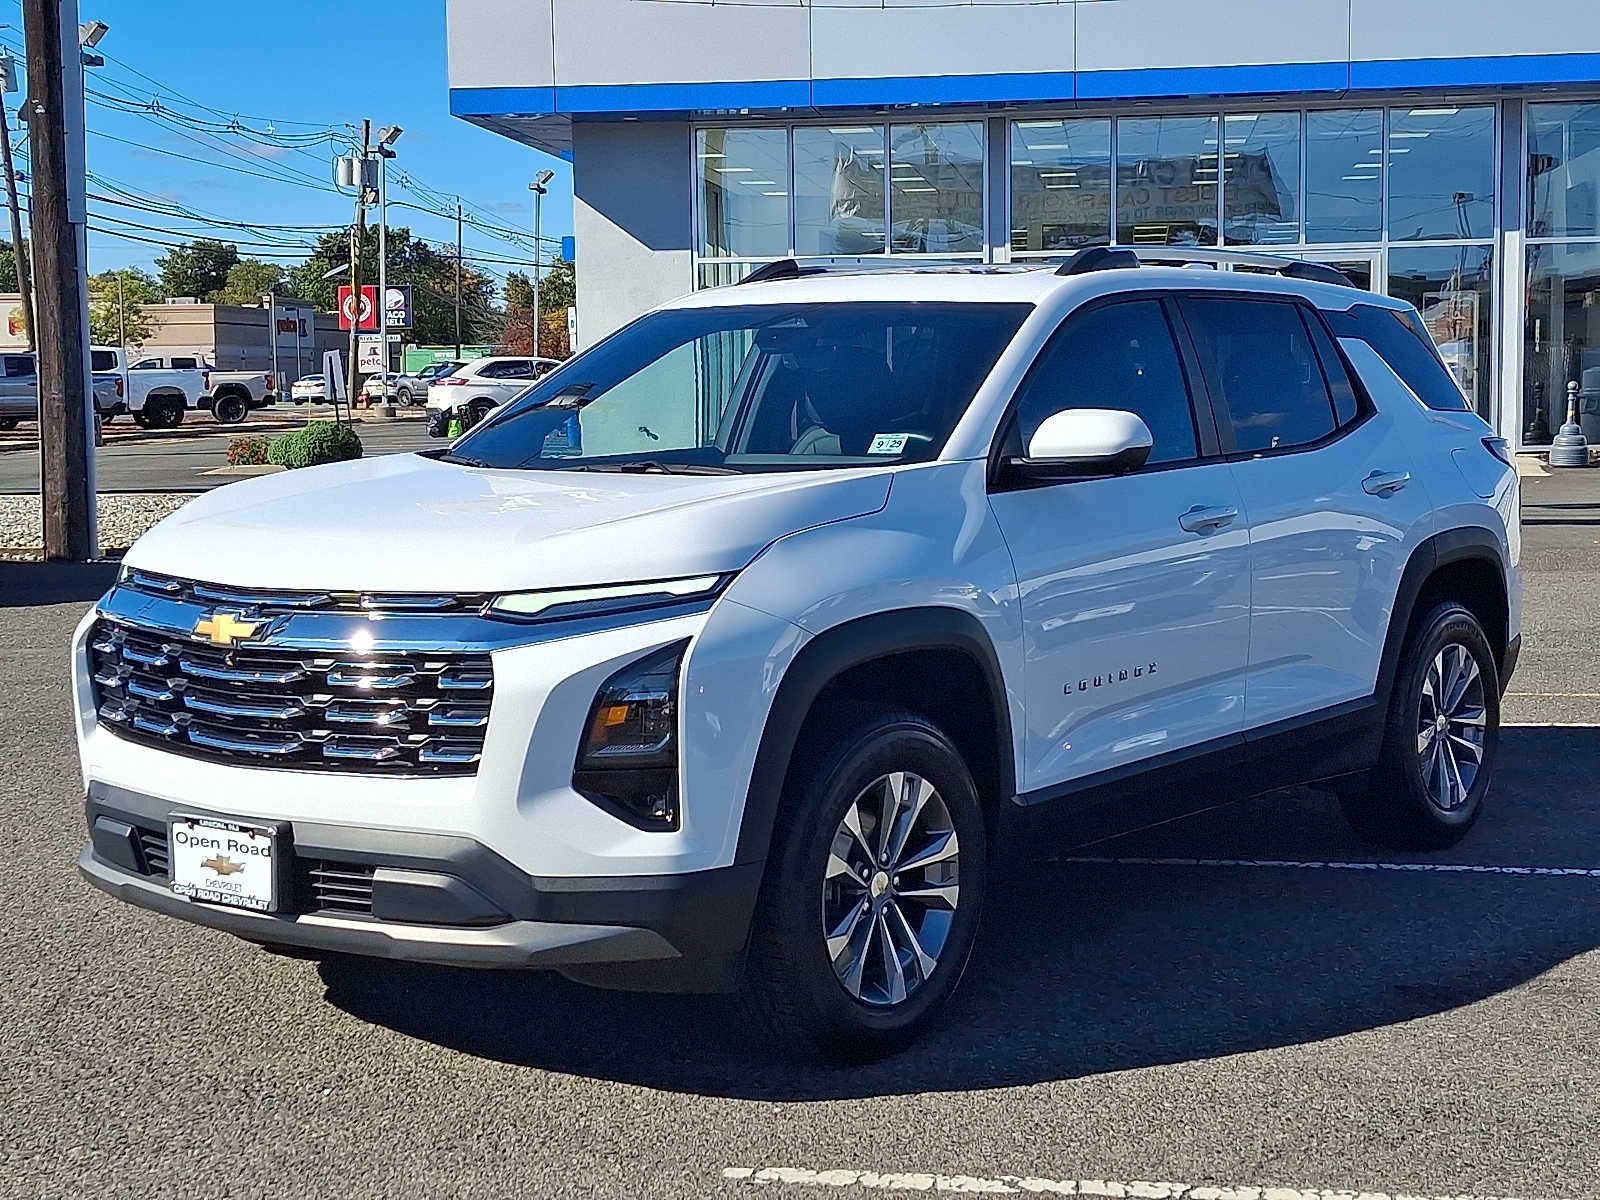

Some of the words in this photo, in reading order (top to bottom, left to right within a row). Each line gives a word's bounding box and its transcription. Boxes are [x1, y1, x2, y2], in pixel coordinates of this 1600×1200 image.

[360, 357, 382, 367] petc
[1063, 662, 1158, 695] EQUINOX
[175, 831, 220, 848] Open
[227, 839, 271, 857] Road
[197, 889, 220, 901] ROAD
[222, 893, 269, 910] CHEVROLET
